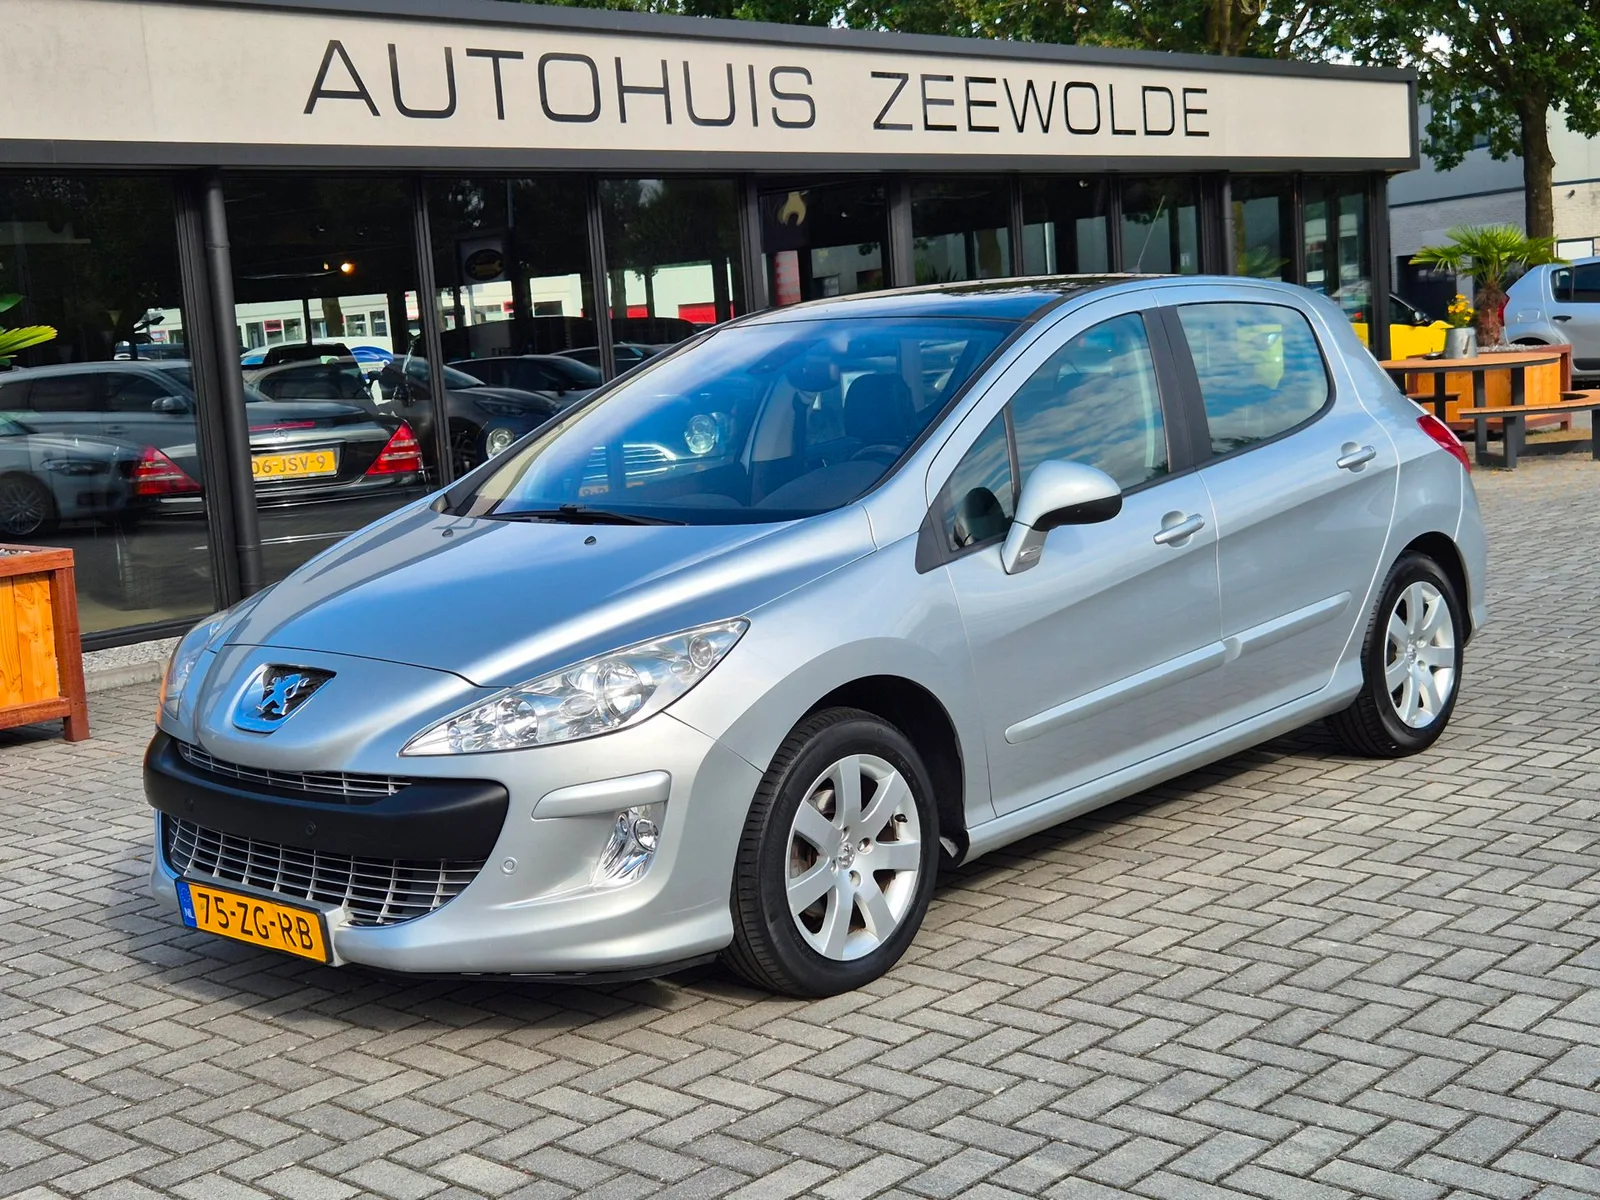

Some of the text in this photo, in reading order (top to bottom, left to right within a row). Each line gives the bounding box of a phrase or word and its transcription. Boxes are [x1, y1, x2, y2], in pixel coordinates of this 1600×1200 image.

[303, 39, 1210, 137] AUTOHUIS ZEEWOLDE
[184, 892, 314, 951] NL 75-ZG-RB
